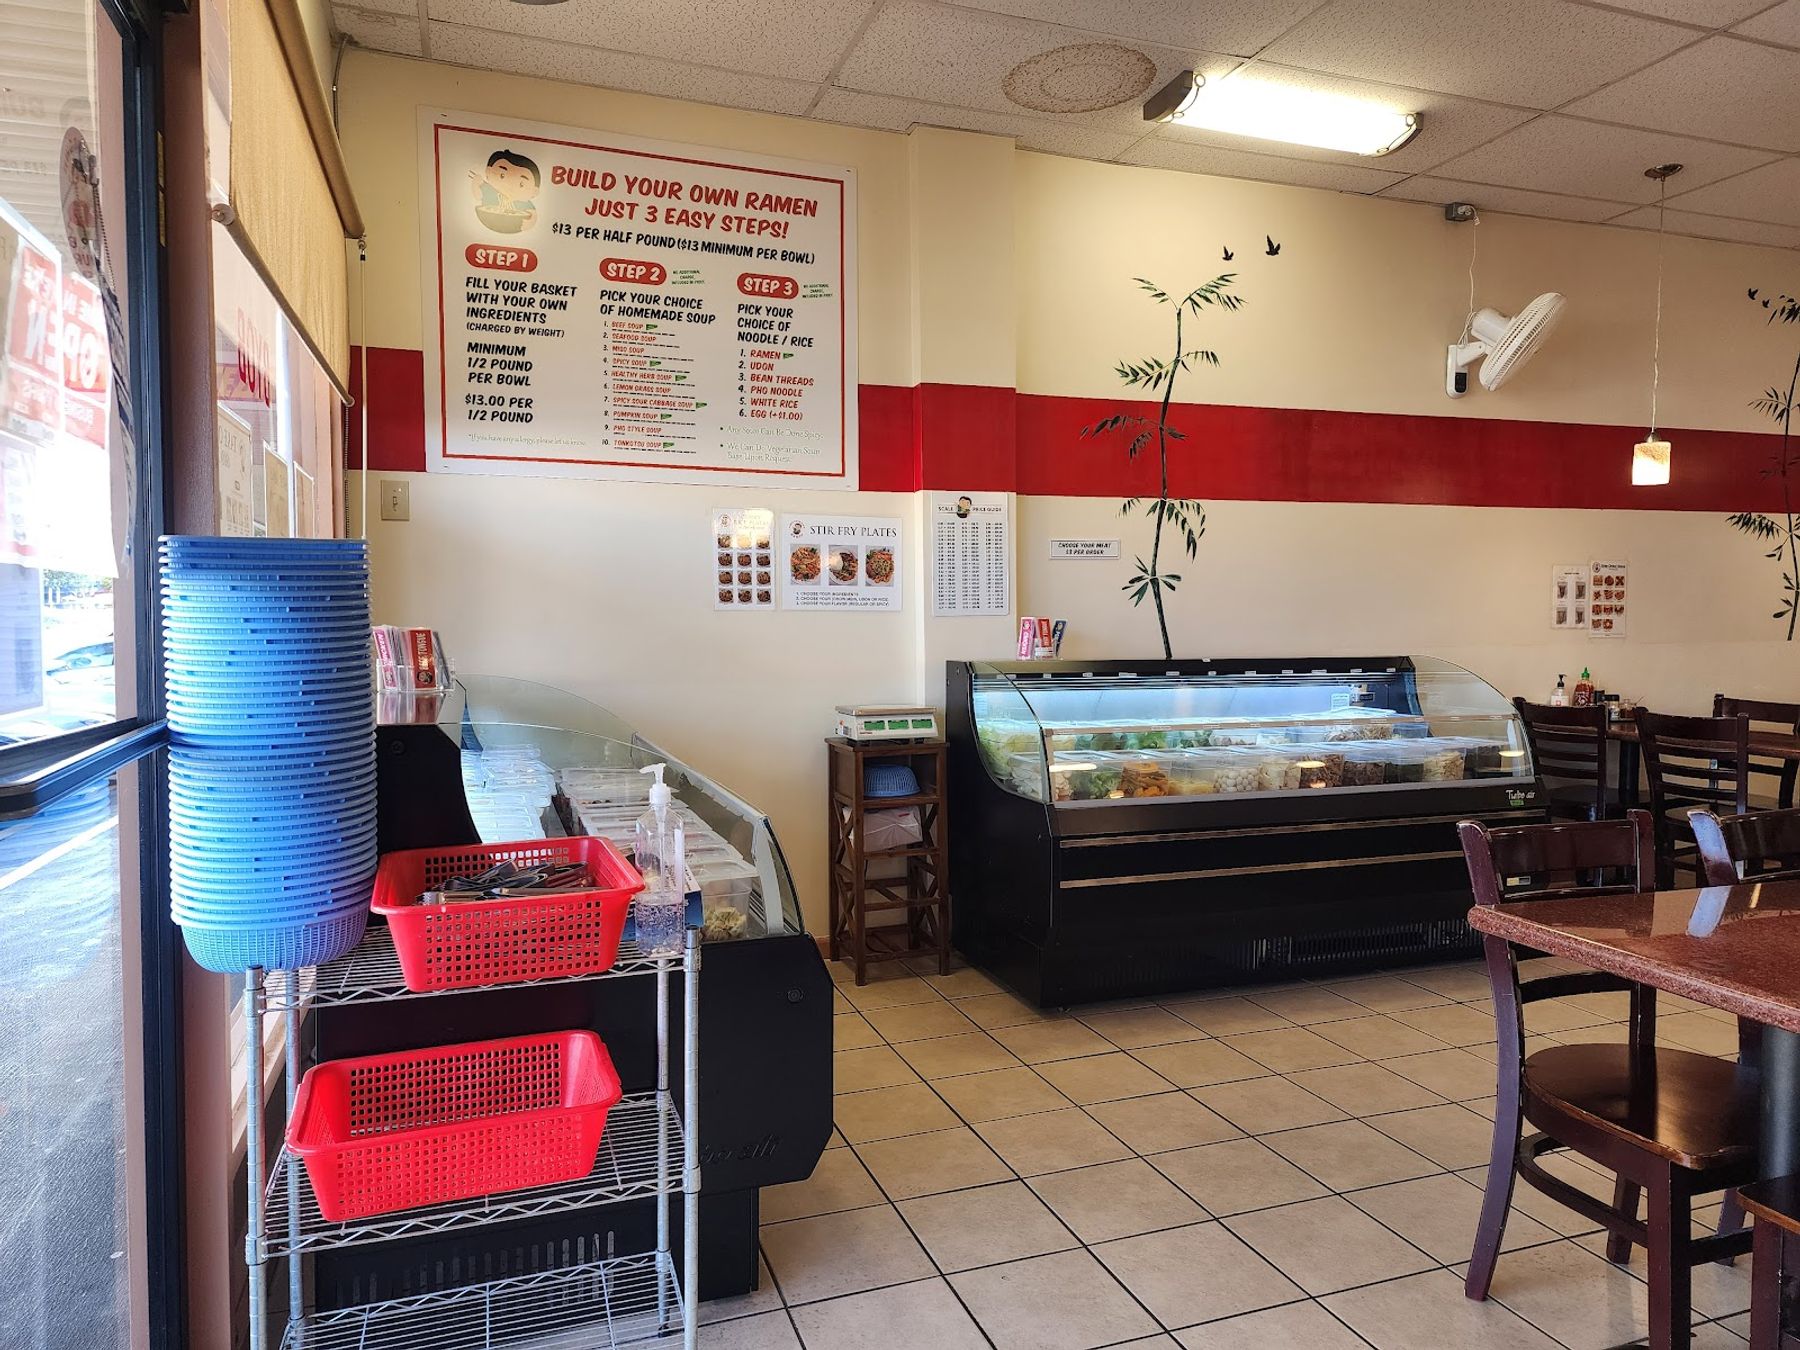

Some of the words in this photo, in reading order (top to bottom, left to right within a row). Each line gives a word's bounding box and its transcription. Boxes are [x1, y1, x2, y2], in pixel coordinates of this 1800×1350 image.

[551, 166, 616, 191] BUILD
[624, 175, 683, 200] YOUR
[689, 185, 739, 208] OWN
[745, 192, 818, 217] RAMEN
[585, 198, 639, 220] JUST
[645, 205, 658, 223] 3
[664, 208, 716, 229] EASY
[720, 214, 790, 239] STEPS!
[552, 223, 572, 235] $13
[576, 227, 600, 240] PER
[603, 229, 632, 243] HALF
[701, 241, 753, 257] MINIMUM
[756, 248, 778, 260] PER
[781, 250, 815, 264] BOWL)
[475, 249, 518, 266] STEP
[522, 254, 528, 268] 1
[607, 263, 646, 280] STEP
[650, 266, 660, 281] 2
[466, 277, 489, 288] FILL
[494, 280, 527, 292] YOUR
[531, 283, 577, 296] BASKET
[744, 277, 780, 293] STEP
[783, 281, 792, 295] 3
[466, 292, 499, 304] WITH
[503, 295, 535, 308] YOUR
[540, 299, 568, 310] OWN
[600, 290, 626, 301] PICK
[630, 292, 660, 305] YOUR
[664, 296, 703, 309] CHOICE
[466, 307, 546, 324] INGREDIENTS
[600, 304, 614, 315] OF
[618, 306, 684, 321] HOMEMADE
[686, 313, 715, 324] SOUP
[738, 304, 762, 315] PICK
[765, 306, 793, 318] YOUR
[466, 322, 511, 334] (CHARGED
[514, 327, 526, 335] BY
[528, 328, 565, 338] WEIGHT)
[738, 318, 774, 330] CHOICE
[778, 322, 791, 332] OF
[612, 333, 639, 341] SEAFOOD
[738, 332, 779, 344] NOODLE
[782, 336, 787, 345] /
[791, 336, 814, 347] RICE
[467, 342, 526, 356] MINIMUM
[740, 349, 745, 357] 1.
[751, 350, 781, 359] RAMEN
[467, 357, 487, 369] 1/2
[491, 358, 533, 371] POUND
[739, 361, 745, 369] 2.
[751, 362, 774, 371] UDON
[468, 372, 492, 383] PER
[497, 374, 531, 386] BOWL
[738, 373, 746, 381] 3.
[751, 374, 772, 382] BEAN
[776, 376, 814, 386] THREADS
[738, 385, 746, 393] 4.
[751, 386, 768, 394] PHO
[770, 387, 803, 397] NOODLE
[465, 393, 504, 406] $13.00
[509, 398, 533, 408] PER
[739, 397, 746, 405] 5.
[751, 398, 777, 407] WHITE
[780, 400, 798, 408] RICE
[468, 410, 487, 421] 1/2
[491, 411, 533, 423] POUND
[739, 409, 747, 417] 6.
[751, 410, 766, 418] EGG
[810, 526, 835, 536] STIR
[838, 526, 857, 536] FRY
[861, 527, 897, 537] PLATES
